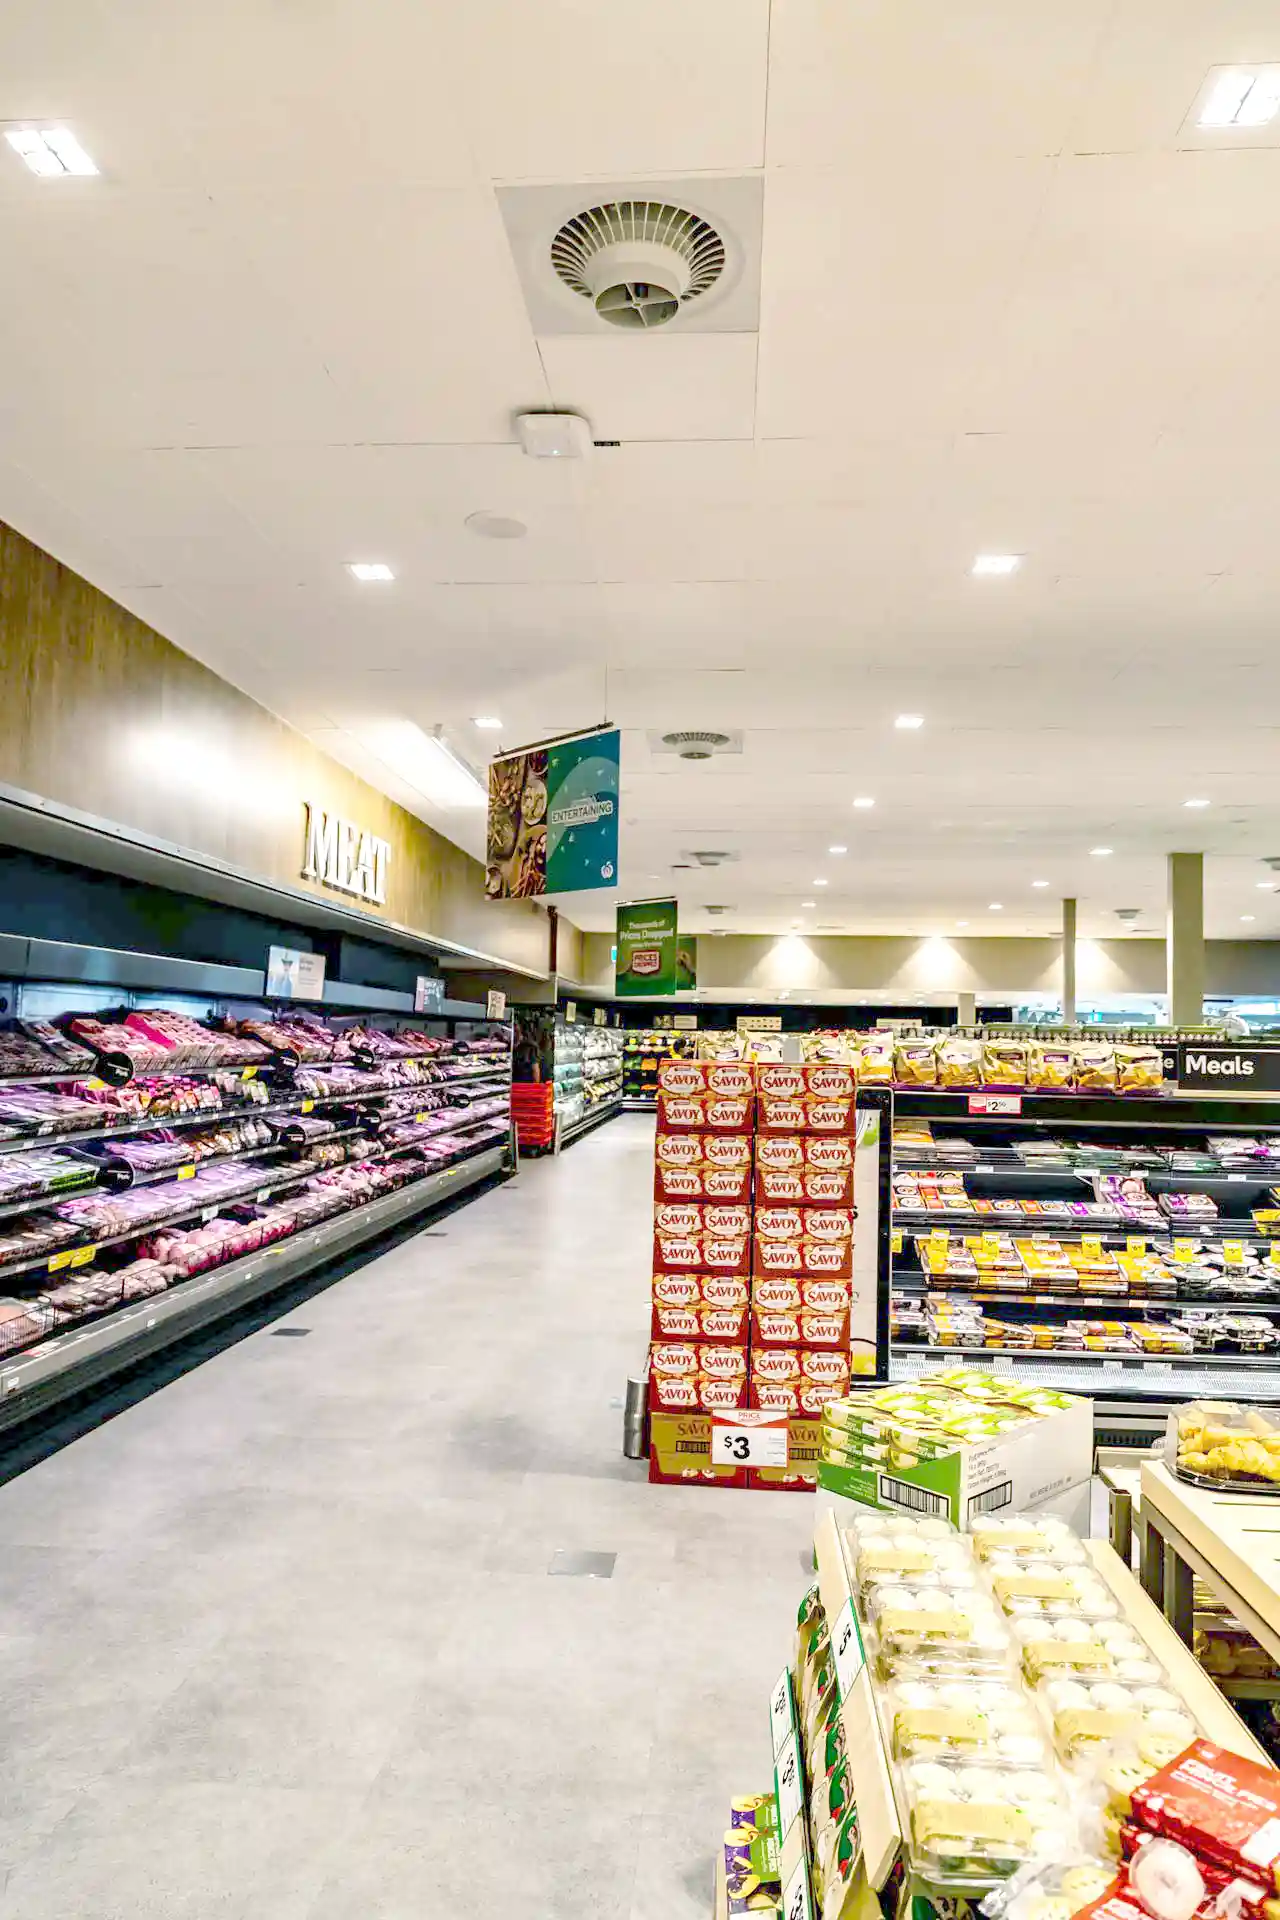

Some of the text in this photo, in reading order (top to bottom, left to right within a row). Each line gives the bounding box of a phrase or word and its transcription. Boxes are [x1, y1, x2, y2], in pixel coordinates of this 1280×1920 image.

[552, 800, 613, 822] ENTERTAINING
[302, 800, 391, 905] MEAT
[1185, 1054, 1255, 1076] Meals
[664, 1074, 701, 1086] SAVOY
[711, 1076, 748, 1088] SAVOY
[764, 1077, 801, 1089] SAVOY
[811, 1078, 849, 1090] SAVOY
[666, 1108, 699, 1120] SAVOY
[766, 1111, 801, 1123] SAVOY
[661, 1144, 698, 1156] SAVOY
[709, 1146, 746, 1158] SAVOY
[762, 1147, 799, 1160] SAVOY
[810, 1149, 848, 1161] SAVOY
[763, 1182, 799, 1193] SAVOY
[661, 1214, 698, 1226] SAVOY
[709, 1216, 746, 1228] SAVOY
[761, 1217, 798, 1230] SAVOY
[809, 1219, 847, 1232] SAVOY
[661, 1248, 697, 1260] SAVOY
[659, 1284, 696, 1296] SAVOY
[707, 1286, 744, 1298] SAVOY
[760, 1289, 797, 1301] SAVOY
[808, 1291, 845, 1304] SAVOY
[659, 1318, 695, 1330] SAVOY
[760, 1324, 796, 1336] SAVOY
[657, 1353, 693, 1366] SAVOY
[704, 1356, 742, 1368] SAVOY
[759, 1359, 796, 1371] SAVOY
[806, 1361, 845, 1373] SAVOY
[738, 1411, 761, 1419] PRICE
[677, 1422, 711, 1437] SAVO
[788, 1425, 819, 1443] AVOY
[724, 1435, 751, 1460] $3
